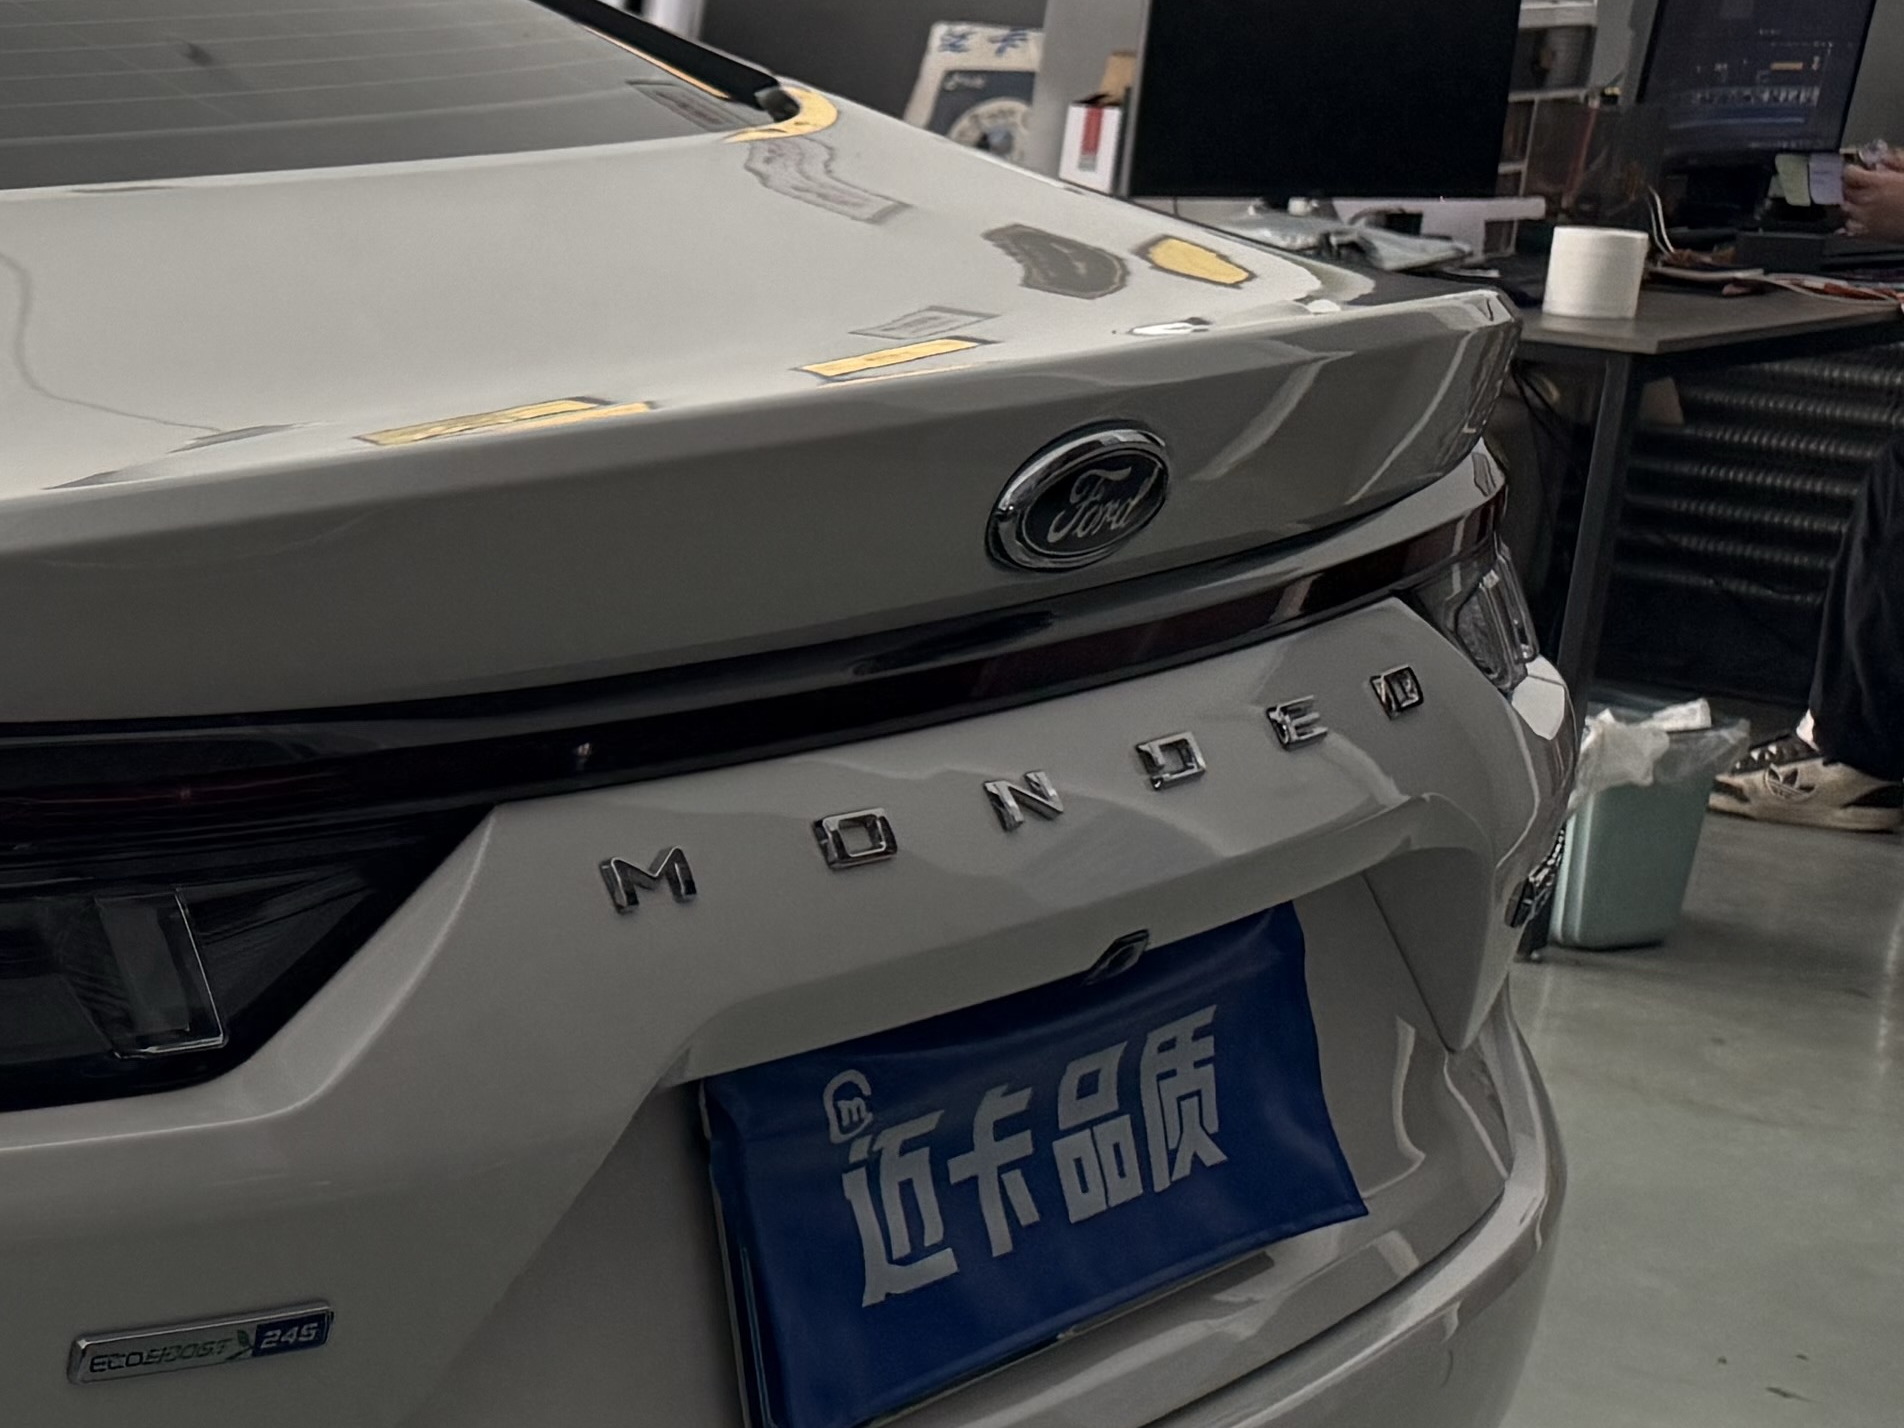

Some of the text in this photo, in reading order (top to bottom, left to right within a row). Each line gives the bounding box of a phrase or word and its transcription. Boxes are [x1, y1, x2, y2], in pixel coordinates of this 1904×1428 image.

[1047, 466, 1162, 544] Ford
[598, 663, 1425, 915] MONDEO
[842, 1006, 1229, 1308] 迈卡品质
